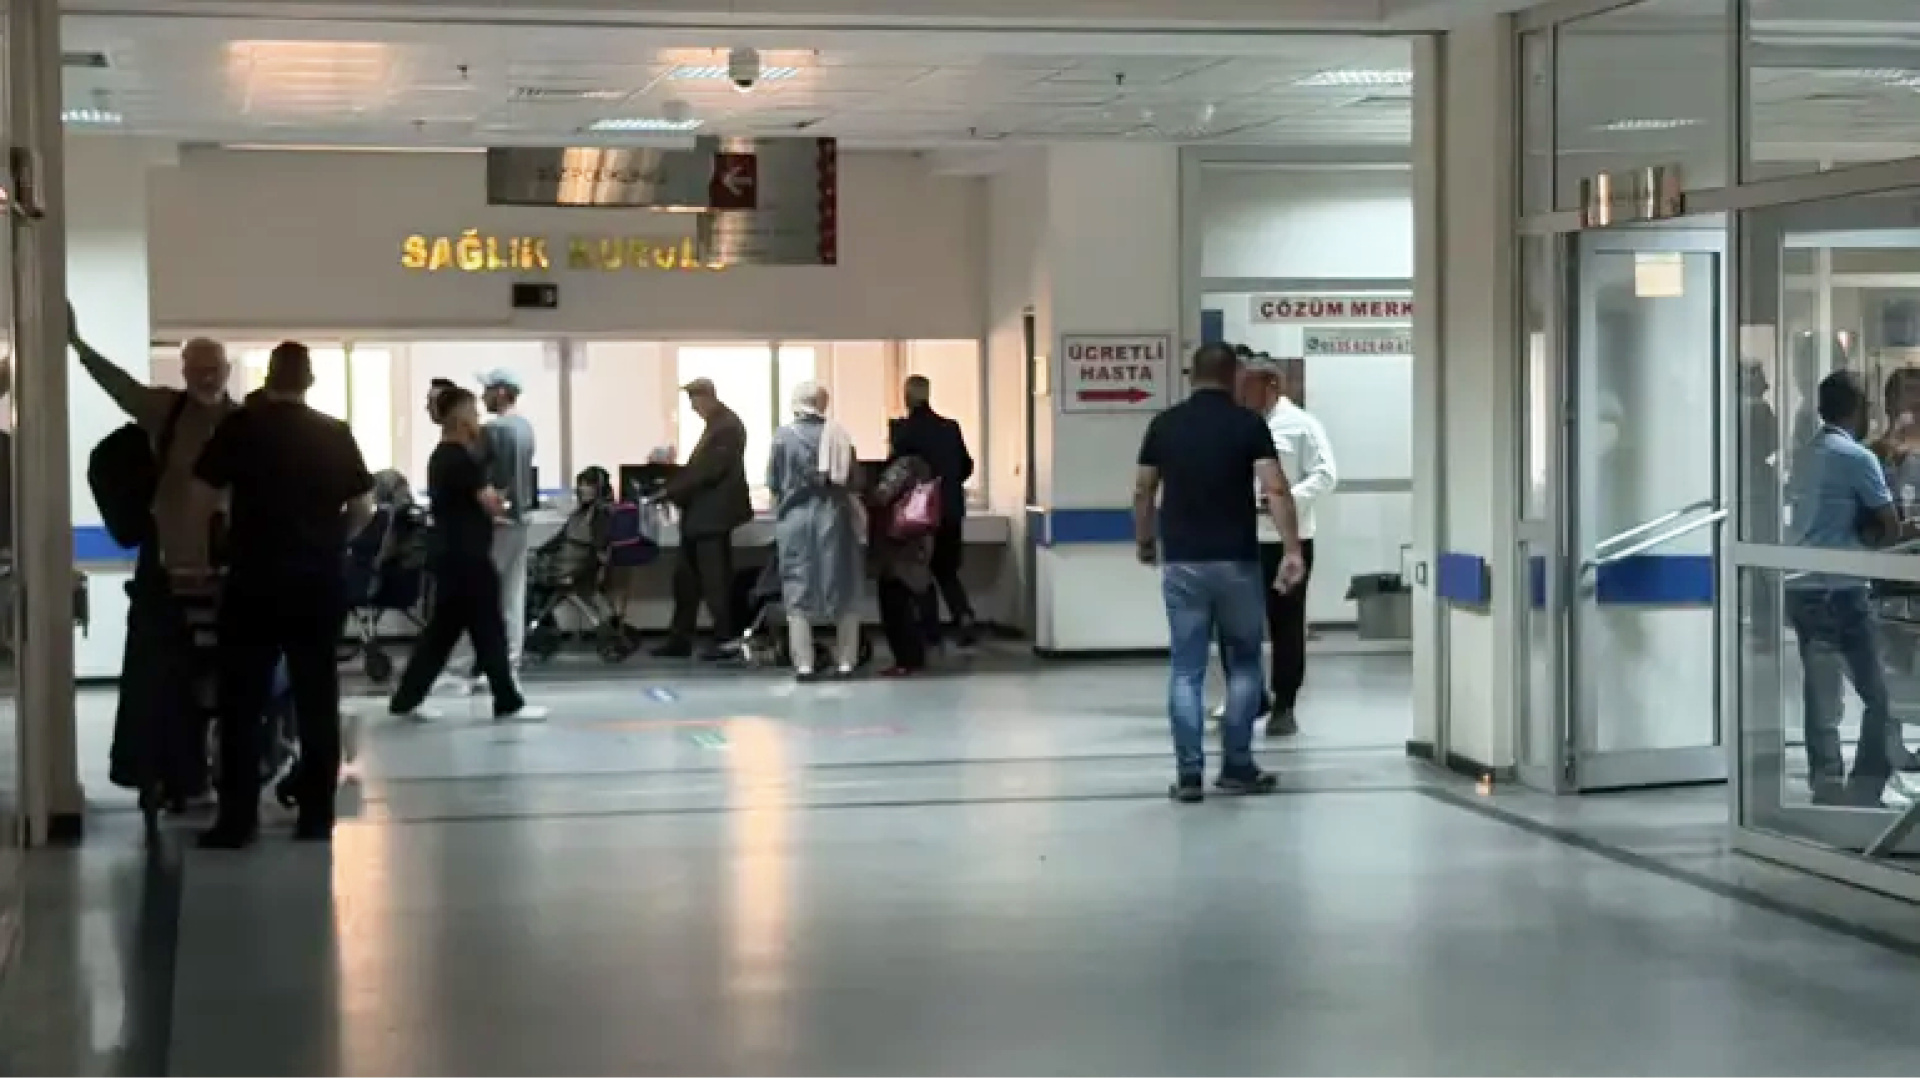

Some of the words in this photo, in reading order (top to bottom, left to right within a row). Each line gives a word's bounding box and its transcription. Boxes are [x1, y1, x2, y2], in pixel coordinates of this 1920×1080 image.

[402, 228, 549, 271] SAĞLIK
[566, 236, 729, 271] KURUL
[1260, 298, 1344, 319] ÇÖZÜM
[1067, 341, 1165, 360] ÜCRETLİ
[1080, 365, 1152, 380] HASTA
